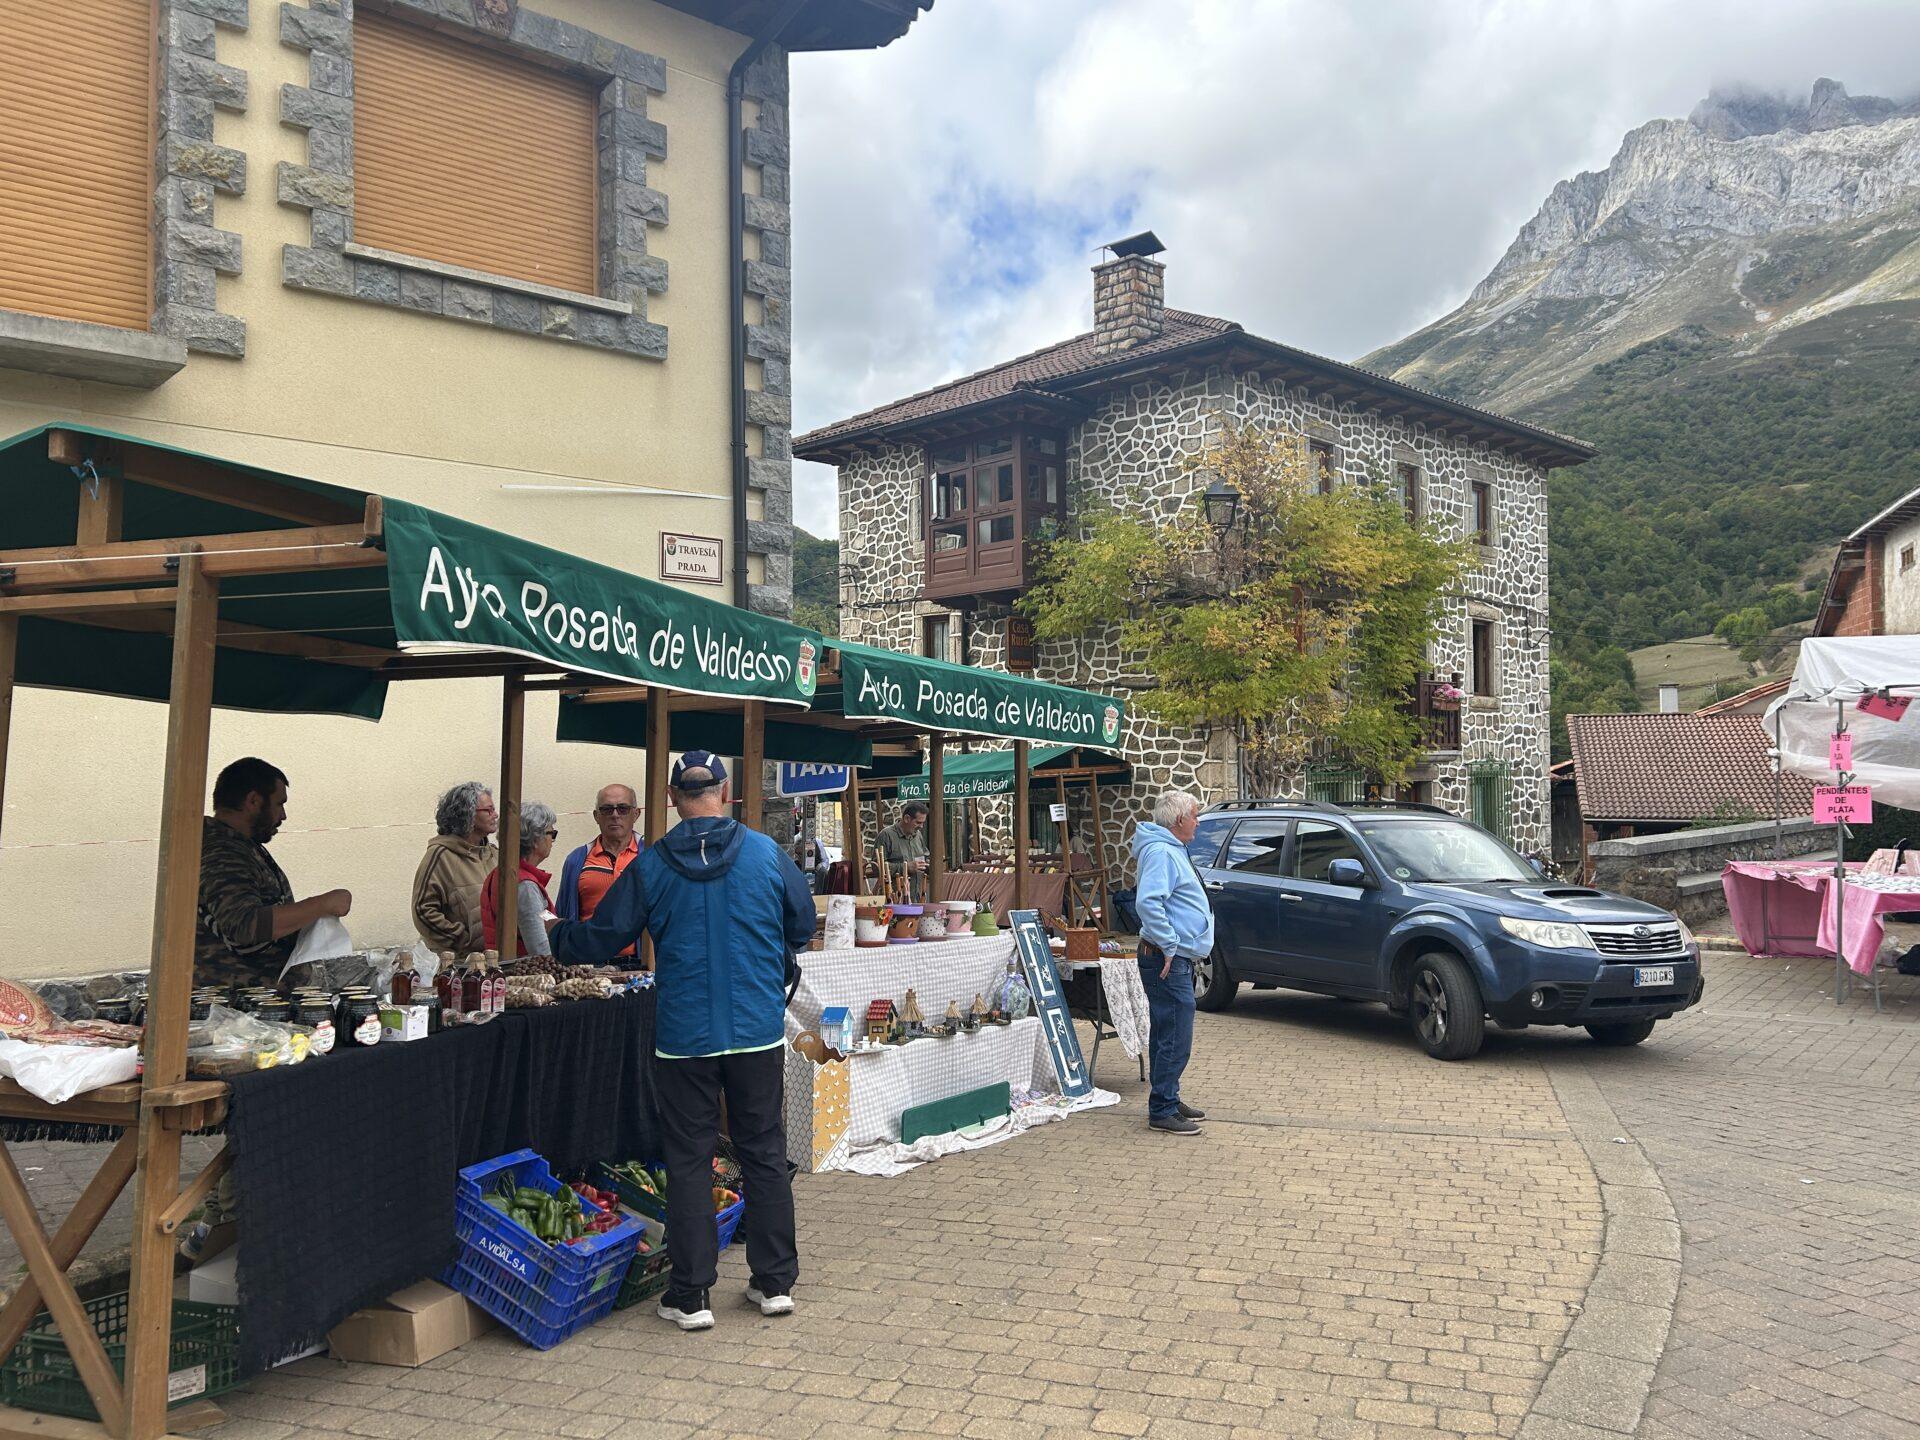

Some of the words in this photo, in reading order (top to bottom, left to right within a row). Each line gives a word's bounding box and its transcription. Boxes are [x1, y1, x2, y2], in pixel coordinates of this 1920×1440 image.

[678, 545, 717, 557] TRAVESÍA
[678, 562, 707, 572] PRADA
[521, 581, 640, 660] Posada
[649, 619, 685, 670] de
[692, 624, 792, 683] Valdeón
[1012, 621, 1029, 633] Casa
[916, 679, 988, 721] Posada
[994, 694, 1021, 725] de
[1025, 697, 1095, 734] Valdeón
[957, 780, 970, 794] de
[1834, 796, 1847, 804] DE
